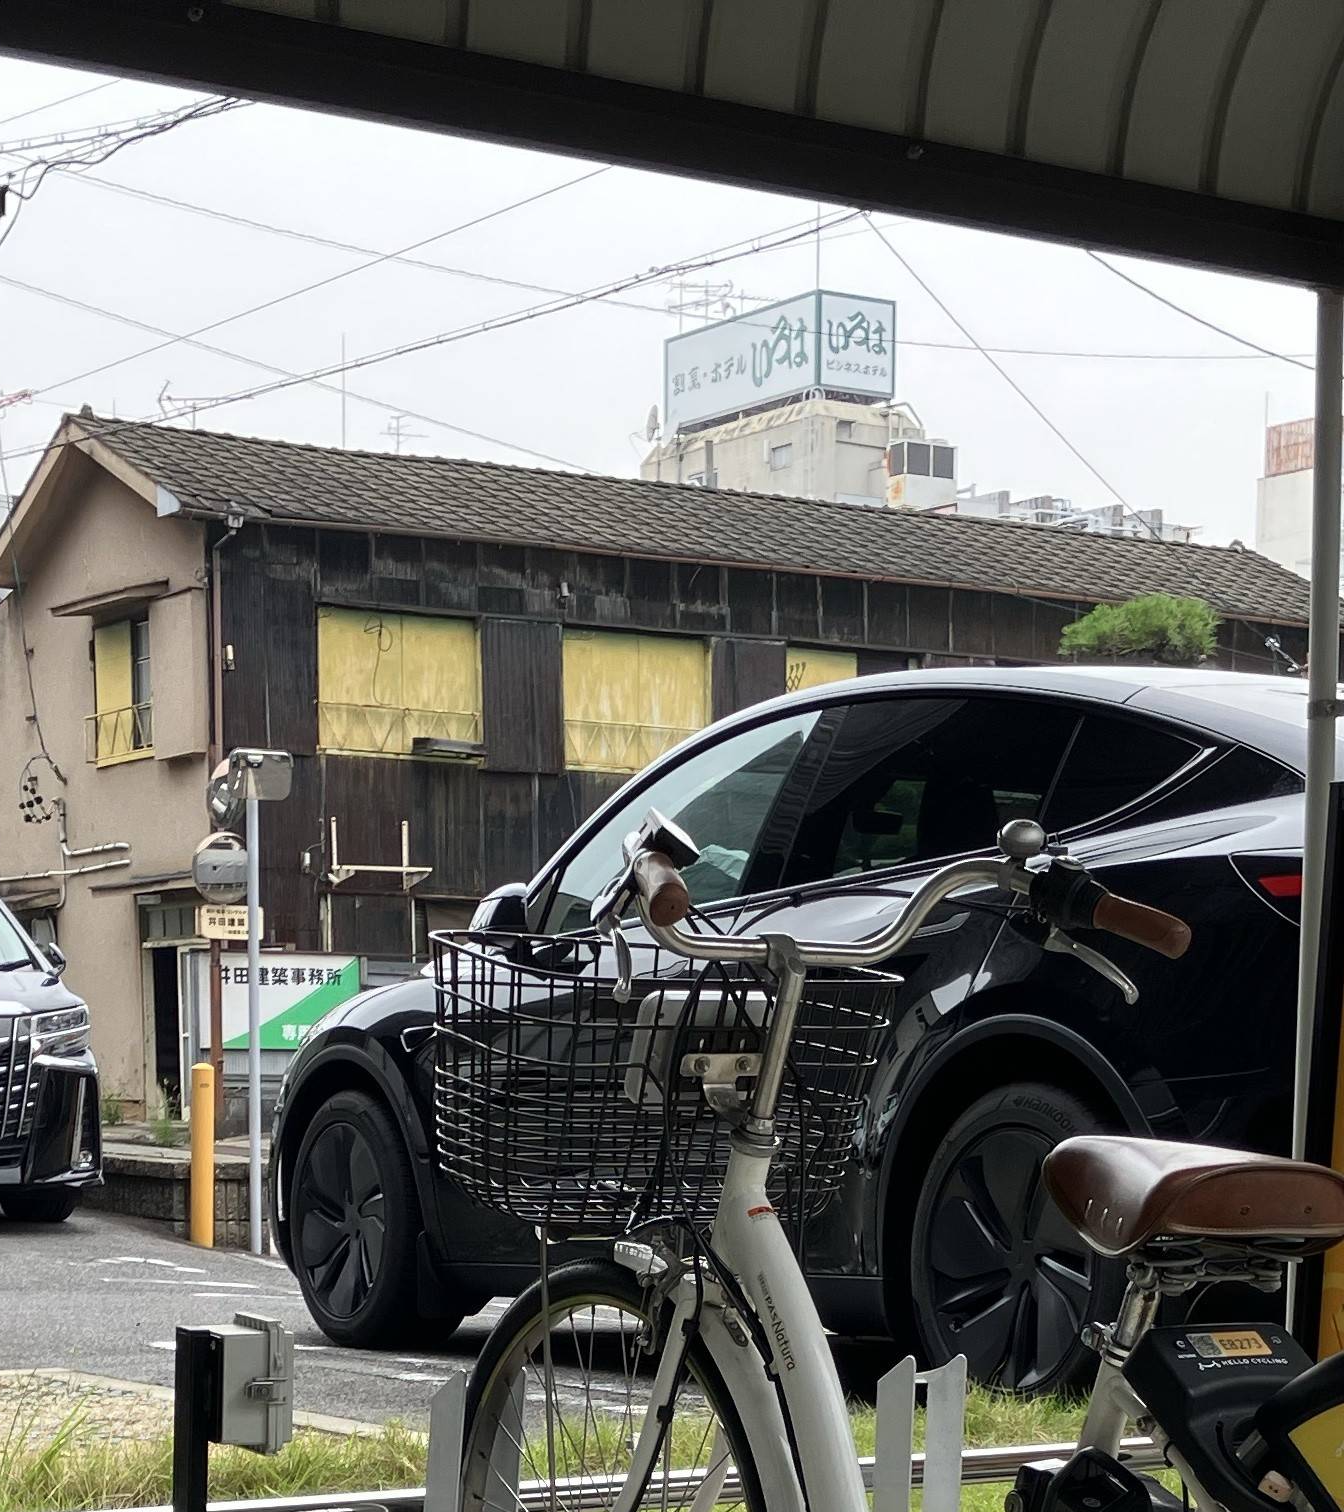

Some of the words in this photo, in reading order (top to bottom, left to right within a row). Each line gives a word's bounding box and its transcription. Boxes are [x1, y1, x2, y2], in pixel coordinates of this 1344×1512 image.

[826, 358, 887, 378] ビジネスホテル
[772, 1320, 796, 1372] Natura
[1221, 1358, 1250, 1367] HELLO
[1251, 1357, 1288, 1366] CYCLING
